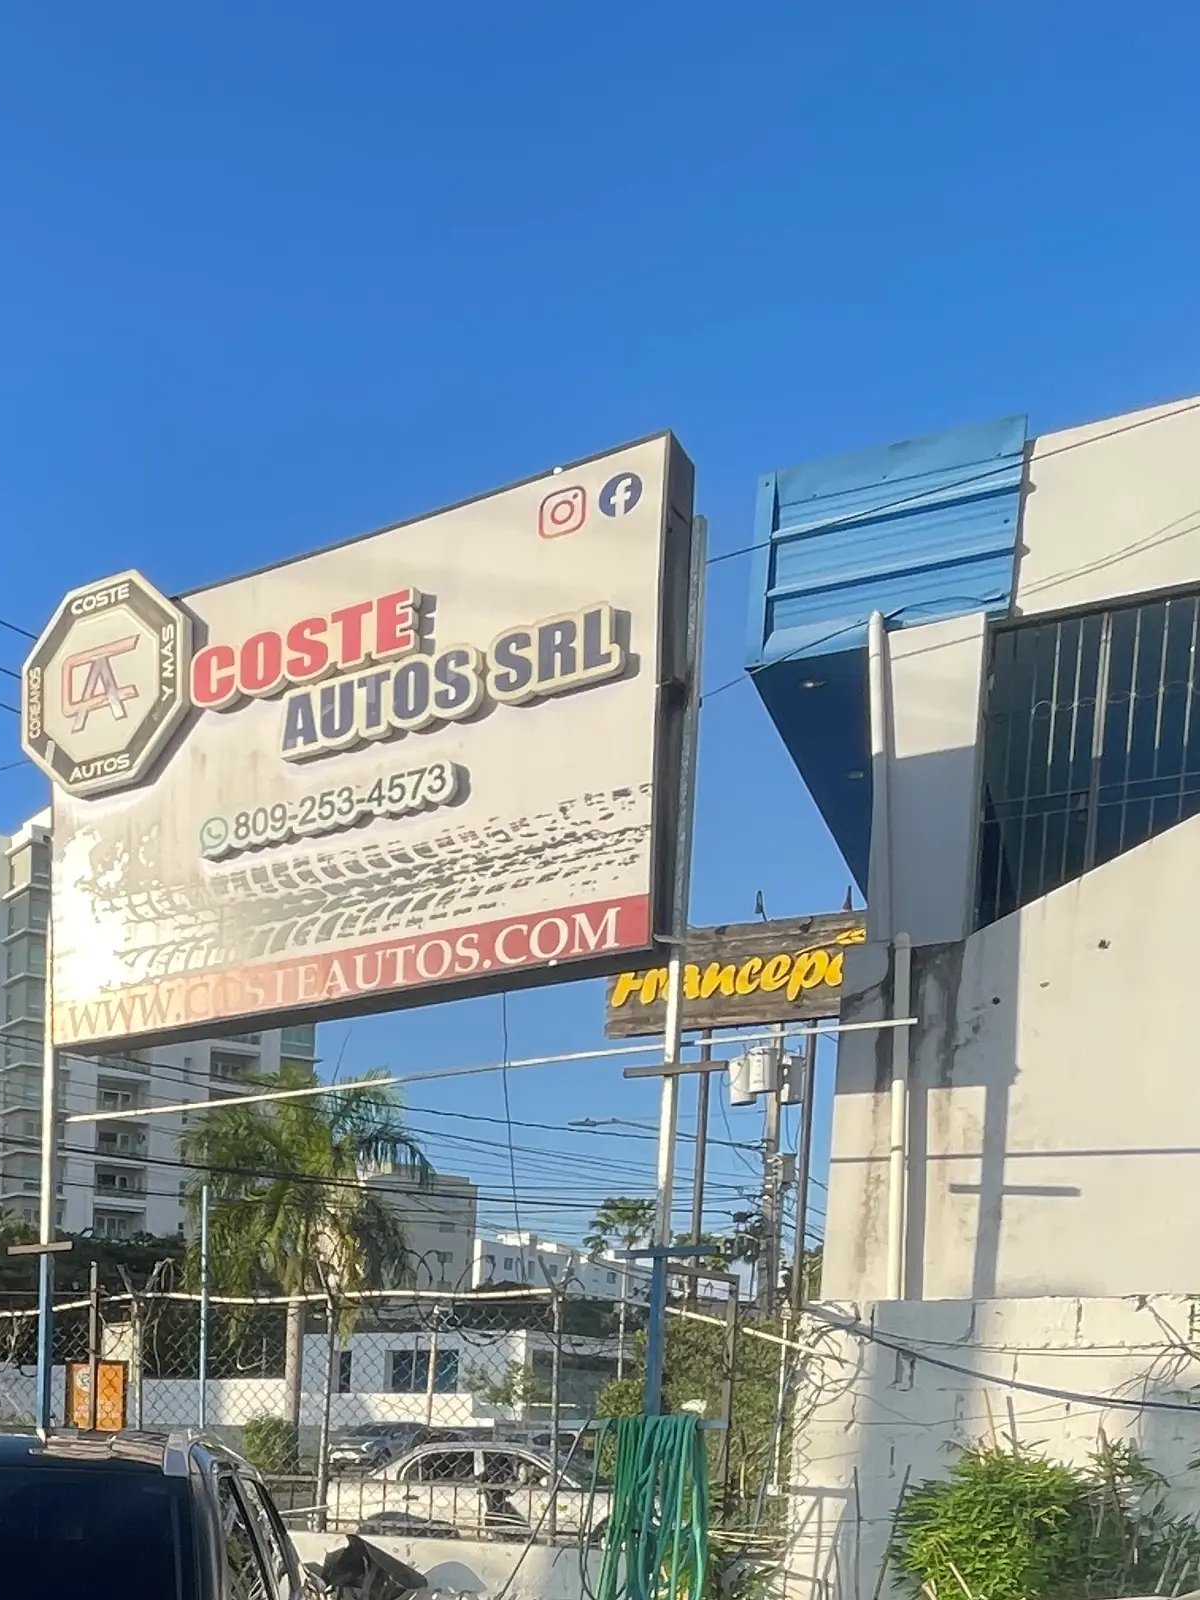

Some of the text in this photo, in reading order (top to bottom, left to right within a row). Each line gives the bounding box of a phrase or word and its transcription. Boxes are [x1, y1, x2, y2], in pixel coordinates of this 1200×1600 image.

[71, 583, 130, 615] COSTE
[192, 588, 413, 704] COSTE
[282, 609, 612, 751] AUTOS SRL
[28, 666, 42, 739] COREANOS
[161, 684, 175, 702] Y
[69, 753, 130, 783] AUTOS
[233, 763, 446, 840] 809-253-4573
[67, 906, 622, 1038] WWW.COSTEAUTOS.COM
